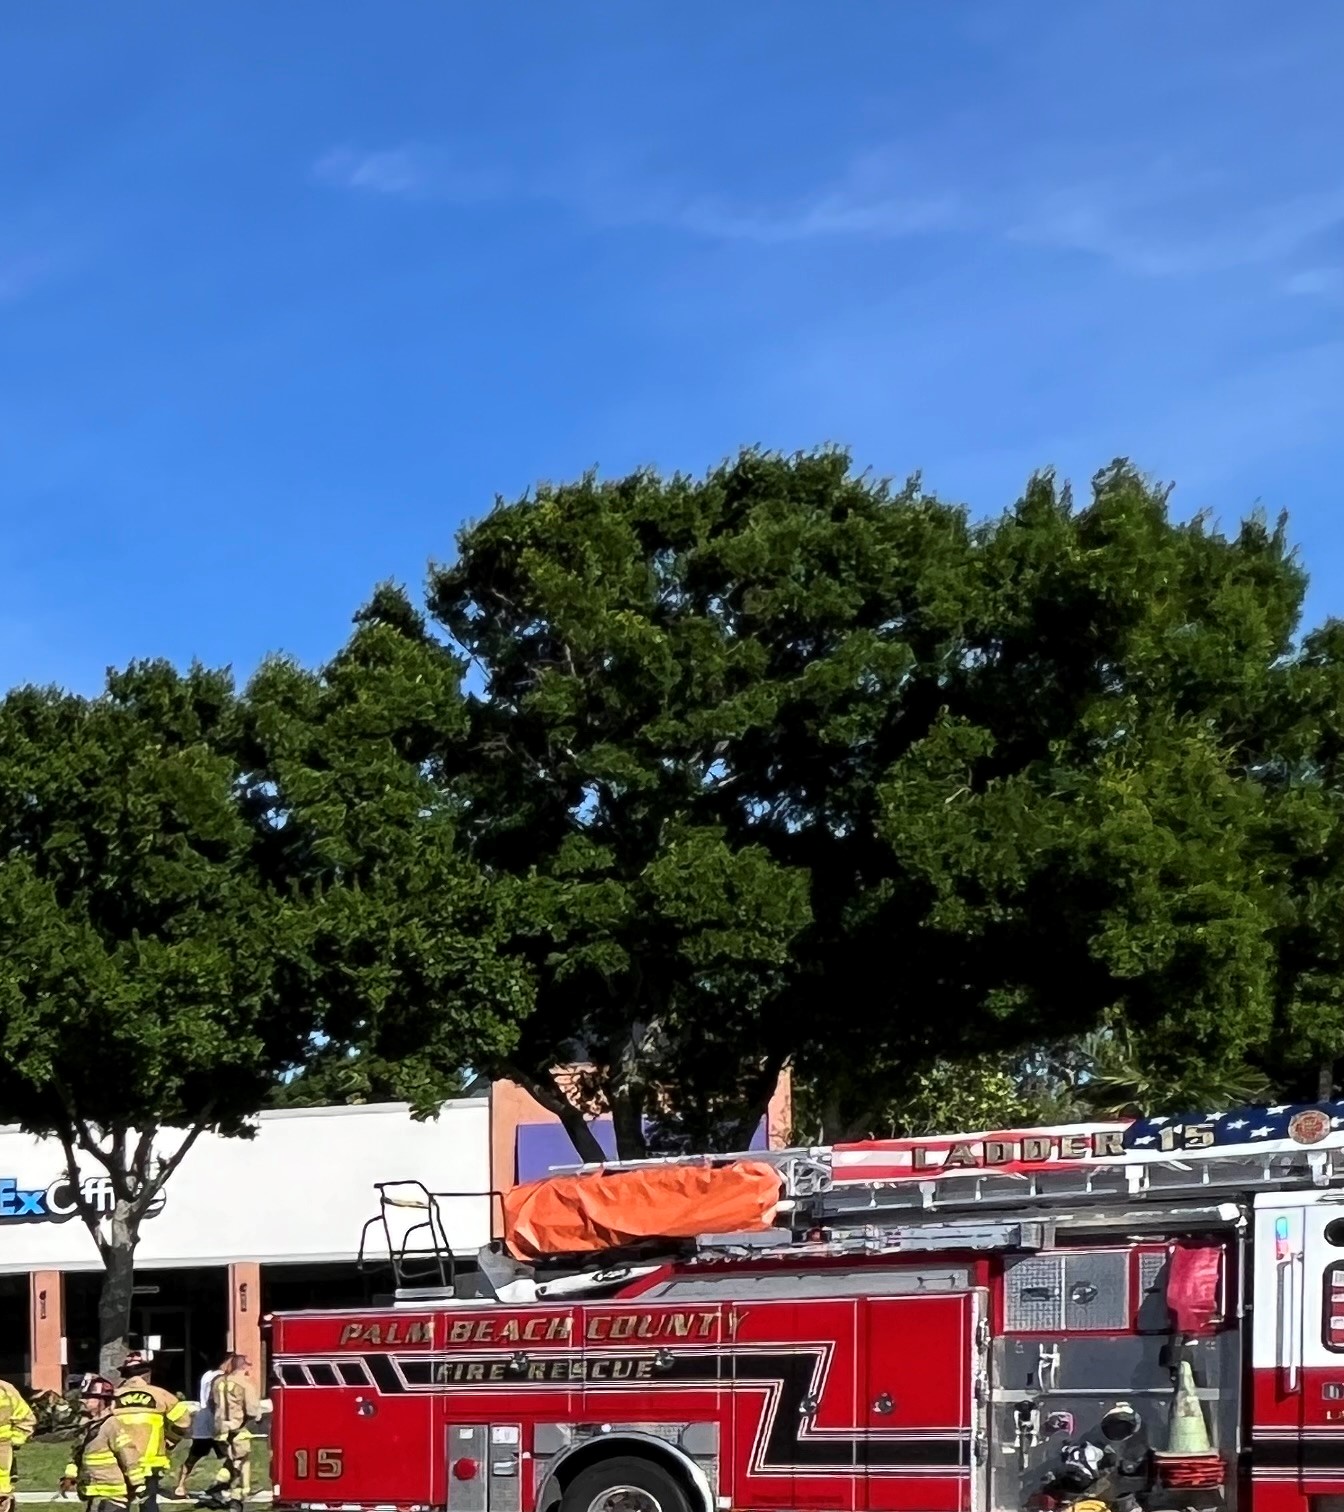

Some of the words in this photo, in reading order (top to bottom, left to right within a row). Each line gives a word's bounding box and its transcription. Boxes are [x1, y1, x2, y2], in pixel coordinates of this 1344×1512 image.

[912, 1131, 1127, 1170] LADDER
[1157, 1123, 1215, 1152] 15
[46, 1177, 166, 1216] Offie
[339, 1320, 434, 1346] PALM
[447, 1316, 575, 1343] BEACH
[586, 1311, 749, 1341] COUNTY
[436, 1364, 506, 1382] FIRE
[527, 1359, 654, 1381] RESCUE
[293, 1448, 344, 1479] 15
